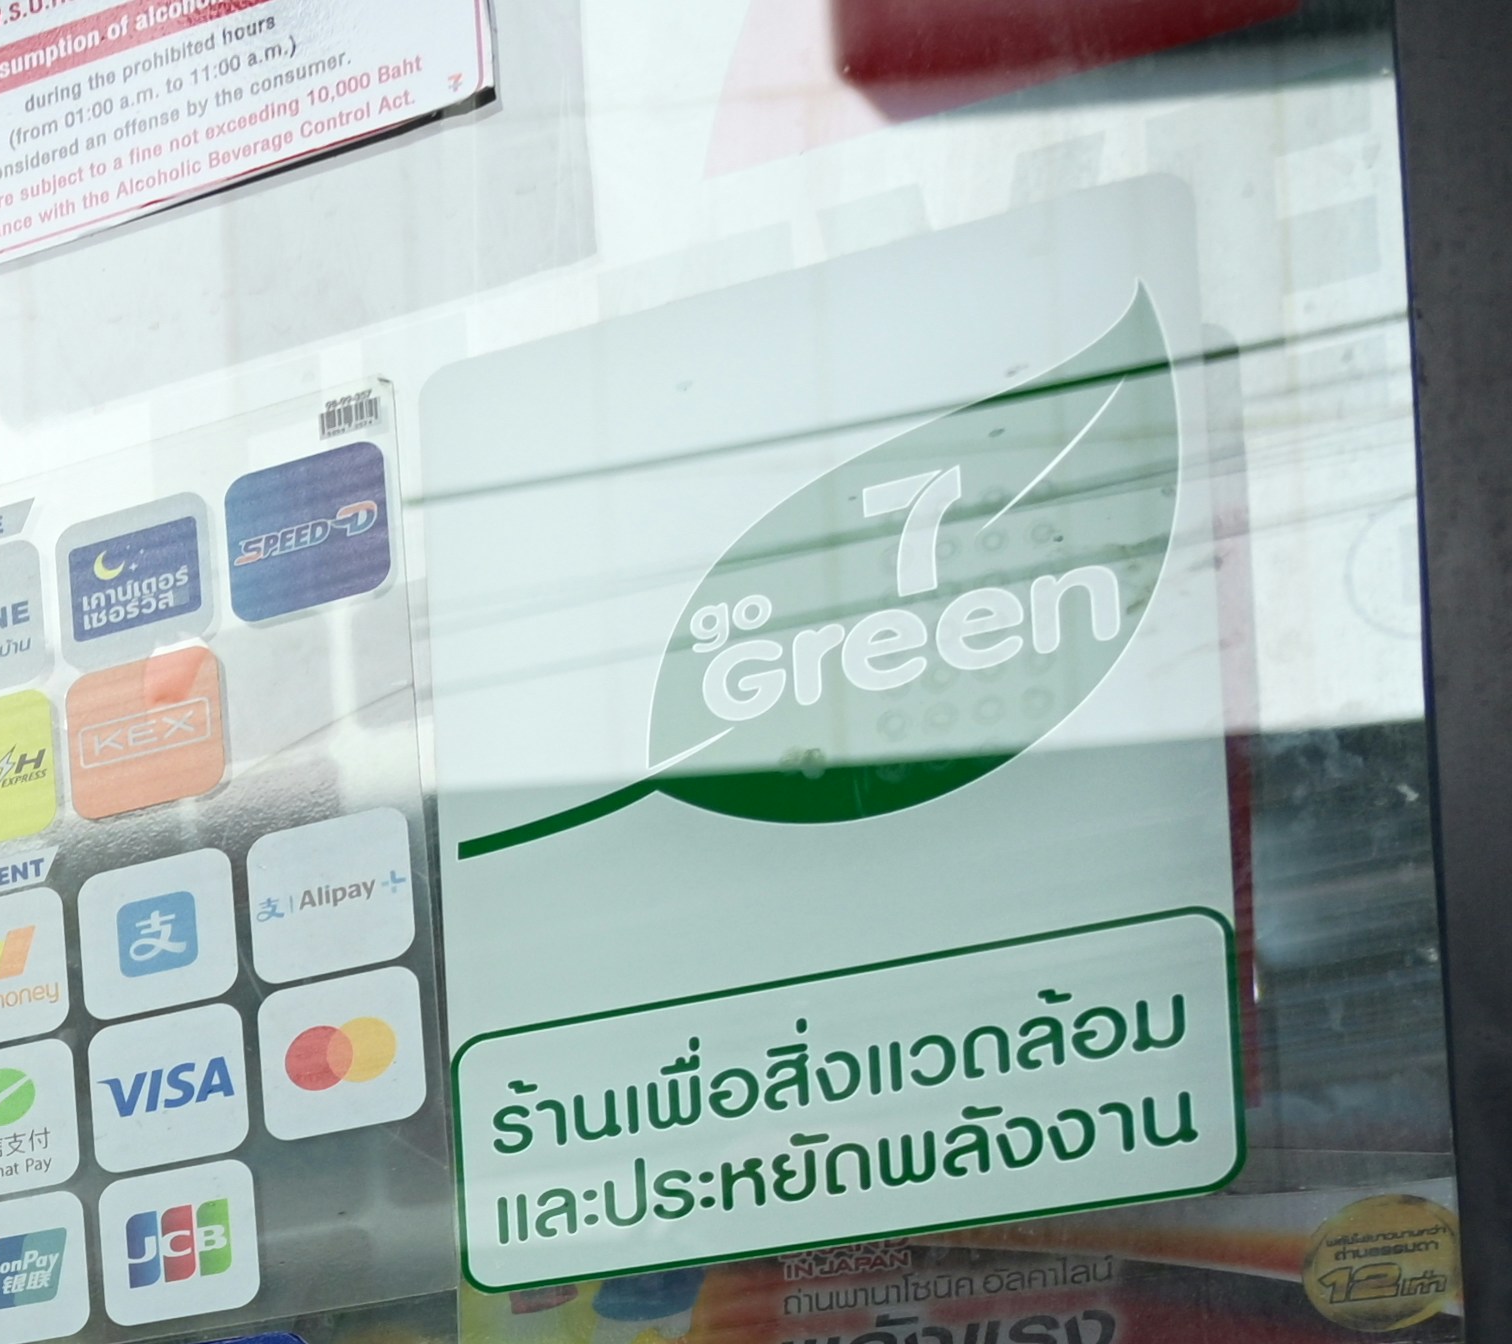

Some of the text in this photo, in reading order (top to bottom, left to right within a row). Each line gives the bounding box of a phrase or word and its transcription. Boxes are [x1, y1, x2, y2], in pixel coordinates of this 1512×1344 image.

[107, 15, 128, 39] of
[10, 34, 297, 151] (from 01:00 a.m. to 11:00 a.m.)
[25, 16, 276, 113] during the prohibited hours
[20, 169, 83, 203] subject
[90, 160, 106, 178] to
[113, 156, 123, 171] a
[129, 142, 162, 166] fine
[170, 132, 199, 152] not
[206, 97, 300, 141] exceeding
[307, 72, 371, 106] 10,000
[378, 54, 423, 84] Baht
[85, 132, 106, 150] an
[113, 110, 180, 141] offense
[187, 95, 209, 119] by
[215, 86, 243, 108] the
[250, 50, 351, 96] consumer.
[39, 198, 75, 224] with
[82, 190, 110, 211] the
[116, 158, 202, 199] Alcoholic
[208, 131, 294, 168] Beverage
[300, 103, 371, 139] Control
[378, 89, 416, 115] Act.
[690, 593, 774, 654] go
[702, 564, 1122, 722] Green
[92, 710, 196, 756] KEX
[2, 768, 47, 790] EXPRESS
[299, 876, 376, 912] Alipay
[97, 1056, 235, 1118] VISA
[492, 988, 1187, 1155] ร้านเพื่อสิ่งแวดล้อม
[24, 1154, 52, 1177] Pay
[495, 1087, 1198, 1246] และประหยัดพลังงาน
[127, 1222, 227, 1264] JCB
[784, 1250, 911, 1281] IN JAPAN
[2, 1271, 50, 1295] 银联
[783, 1255, 1113, 1315] ถ่านพานาโซนิค อัลคาไลน์
[1318, 1262, 1402, 1304] 12
